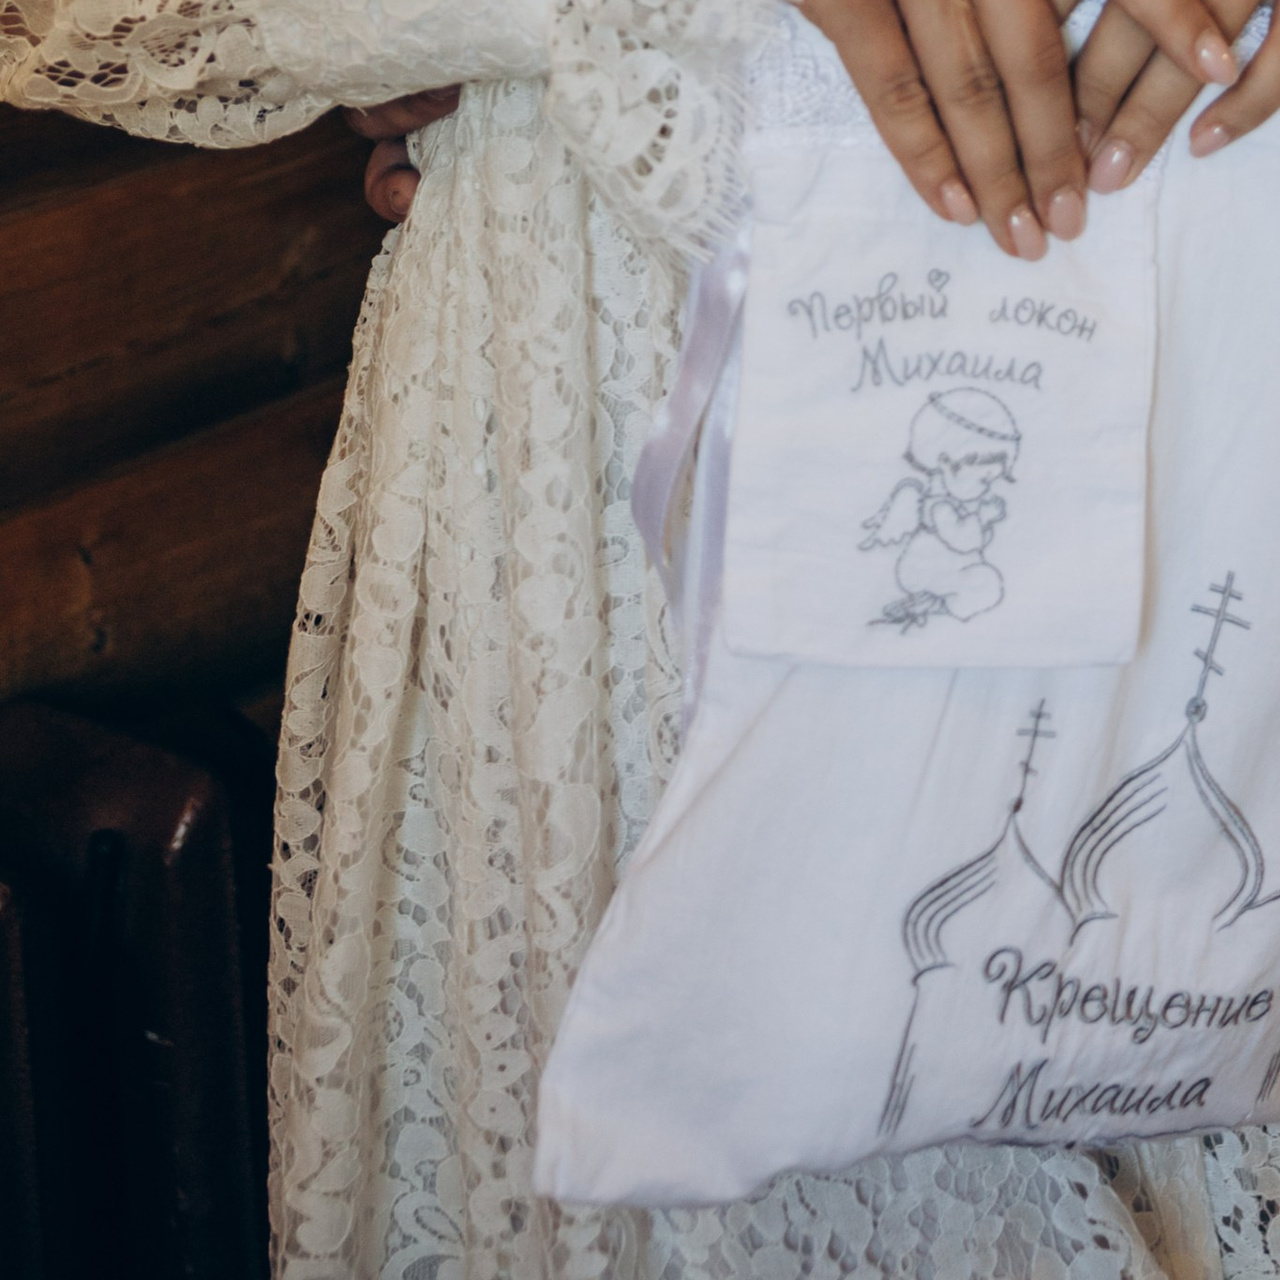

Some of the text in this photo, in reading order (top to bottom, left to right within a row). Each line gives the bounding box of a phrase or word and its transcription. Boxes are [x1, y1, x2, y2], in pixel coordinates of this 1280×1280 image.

[787, 269, 1098, 341] Первый локон
[851, 337, 1044, 392] Михаила
[982, 946, 1275, 1045] Крещение
[968, 1058, 1213, 1129] Михаила
